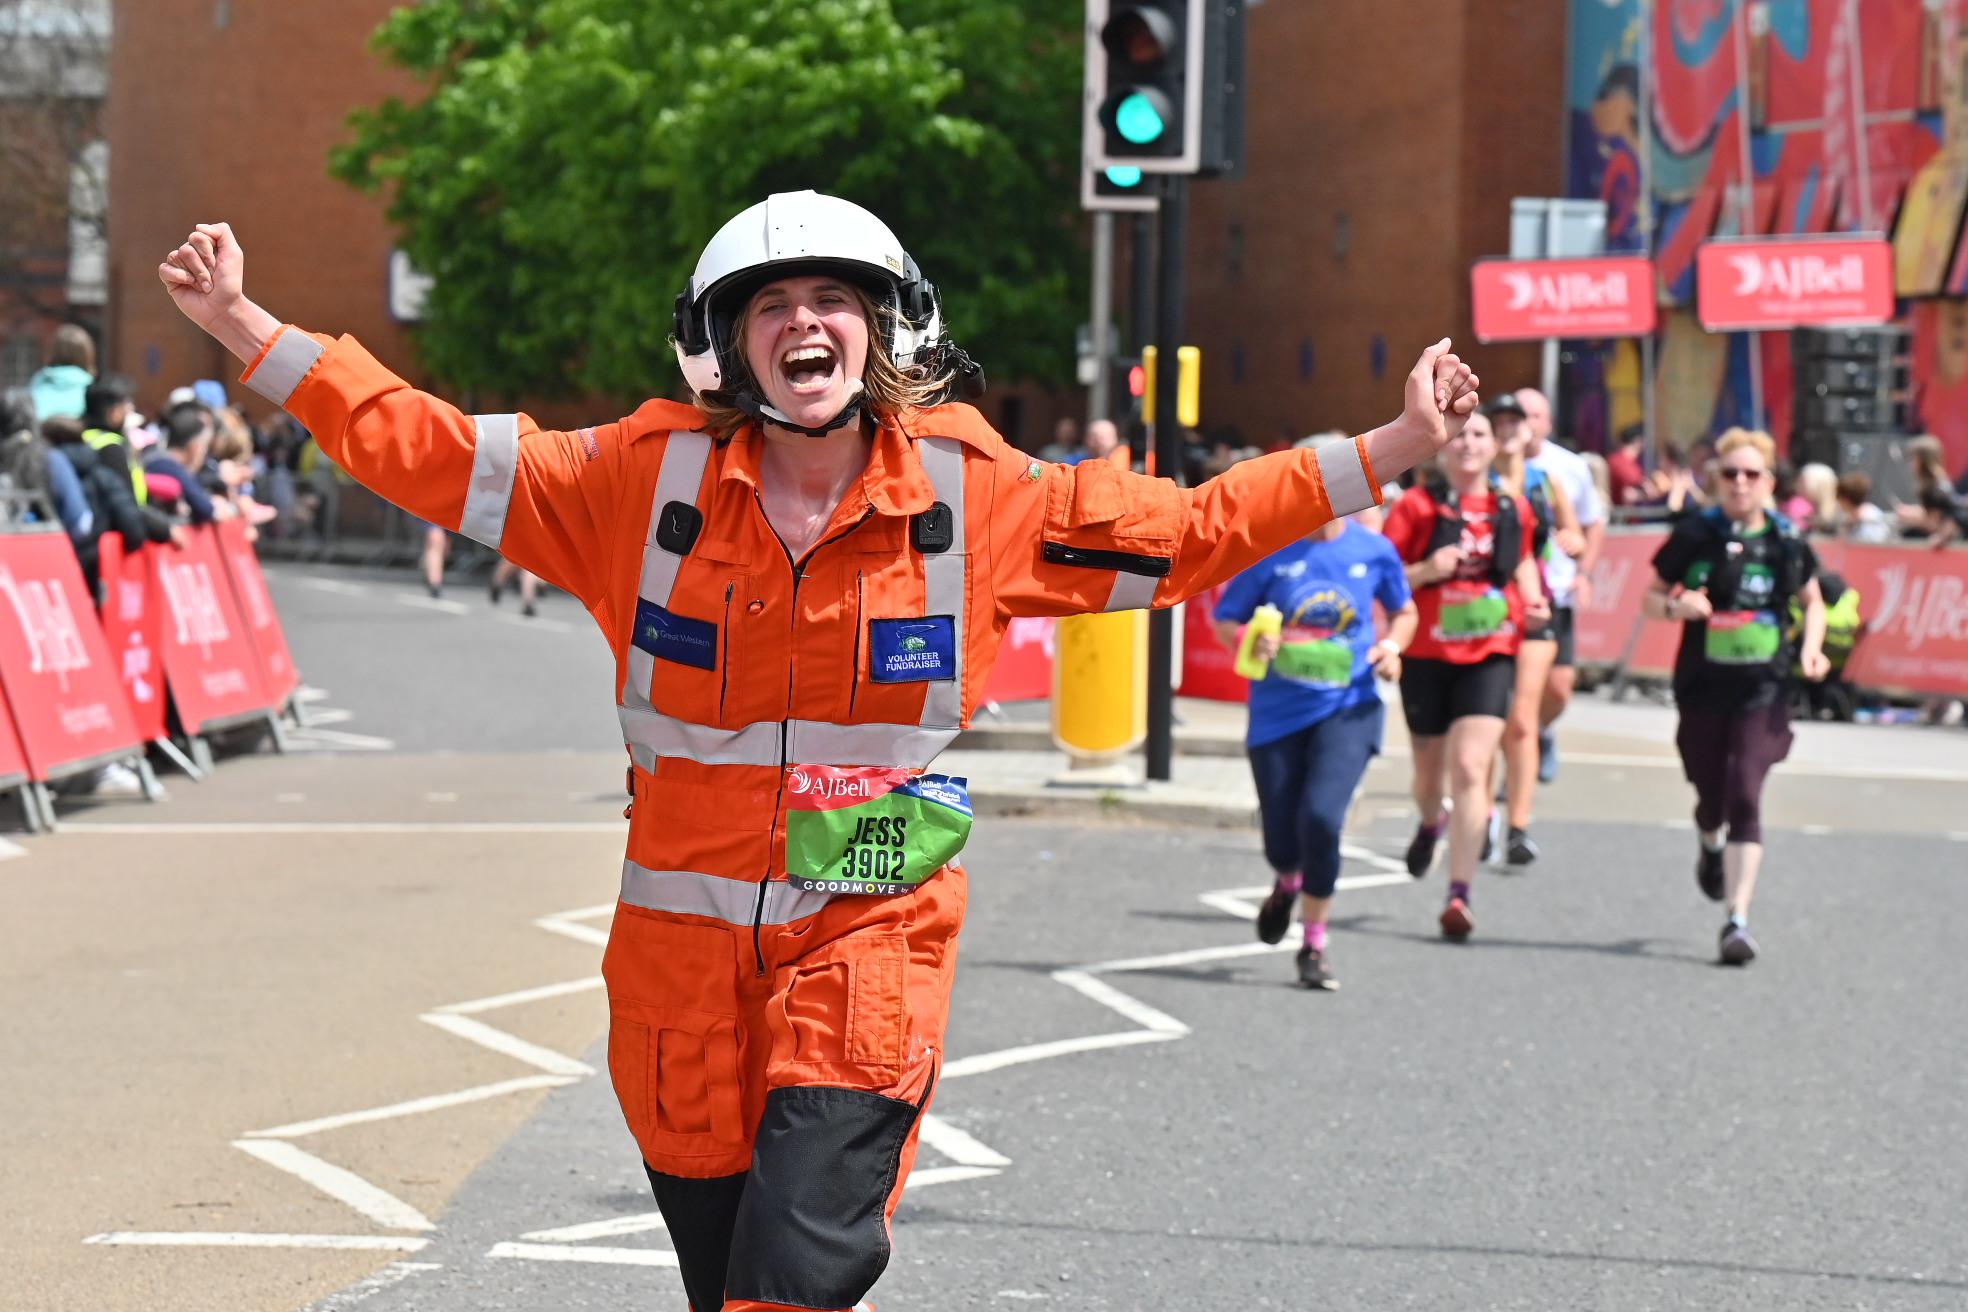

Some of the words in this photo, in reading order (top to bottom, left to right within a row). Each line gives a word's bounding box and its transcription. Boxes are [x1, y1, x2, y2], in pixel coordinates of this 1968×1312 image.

[660, 629, 680, 641] Great
[680, 634, 710, 648] Western
[887, 651, 939, 663] VOLUNTEER
[886, 660, 941, 672] FUNDRAISER
[847, 816, 907, 848] JESS
[841, 847, 905, 880] 3902
[803, 880, 896, 894] GOODMOVE
